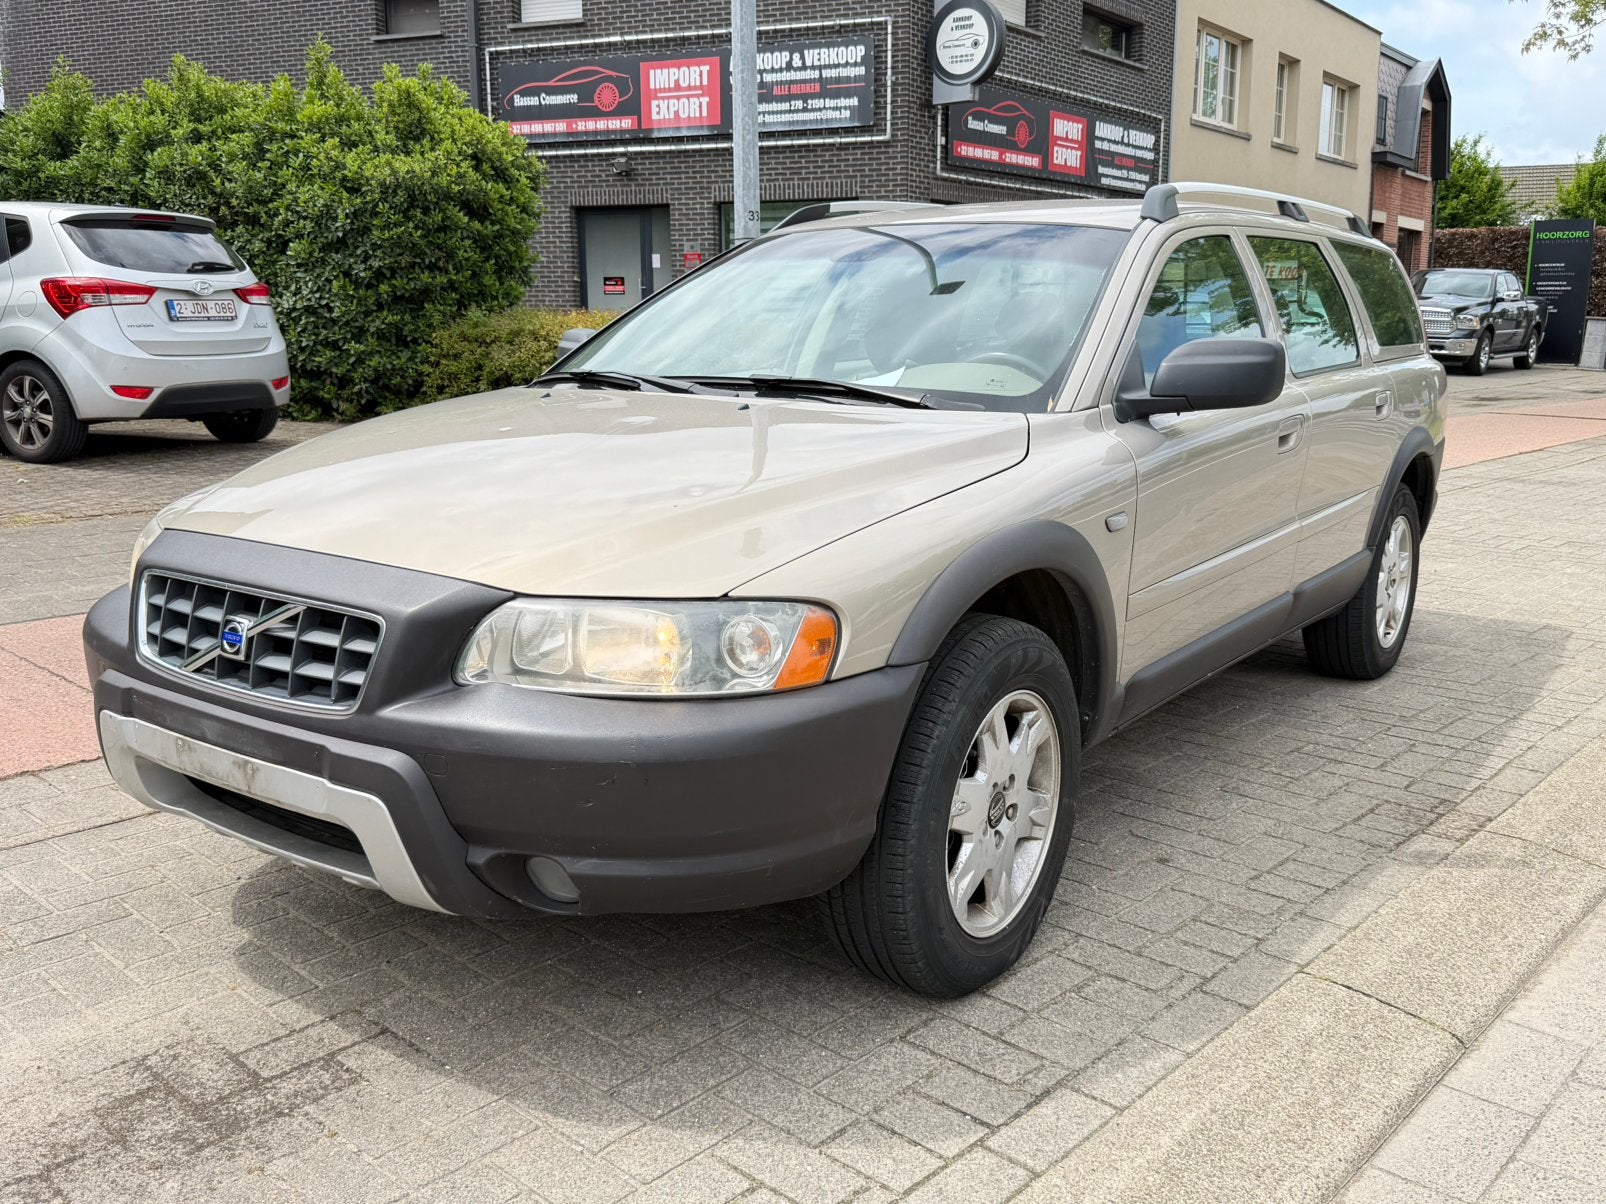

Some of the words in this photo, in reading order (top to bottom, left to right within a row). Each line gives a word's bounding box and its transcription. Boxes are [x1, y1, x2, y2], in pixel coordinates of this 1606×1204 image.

[730, 51, 790, 71] KOOP
[792, 53, 802, 67] &
[804, 46, 865, 66] VERKOOP
[649, 65, 710, 90] IMPORT
[763, 68, 819, 82] tweedehandse
[773, 85, 789, 95] ALLE
[790, 83, 820, 94] MERKEN
[514, 94, 539, 106] Hassan
[540, 92, 578, 105] Commerce
[652, 96, 710, 120] EXPORT
[791, 100, 803, 110] 279
[808, 98, 824, 108] 2150
[1054, 118, 1082, 141] IMPORT
[1095, 121, 1123, 141] AANKOOP
[1129, 129, 1155, 149] VERKOOP
[1053, 146, 1081, 168] EXPORT
[748, 210, 759, 221] 33
[1536, 231, 1590, 239] HOORZORG
